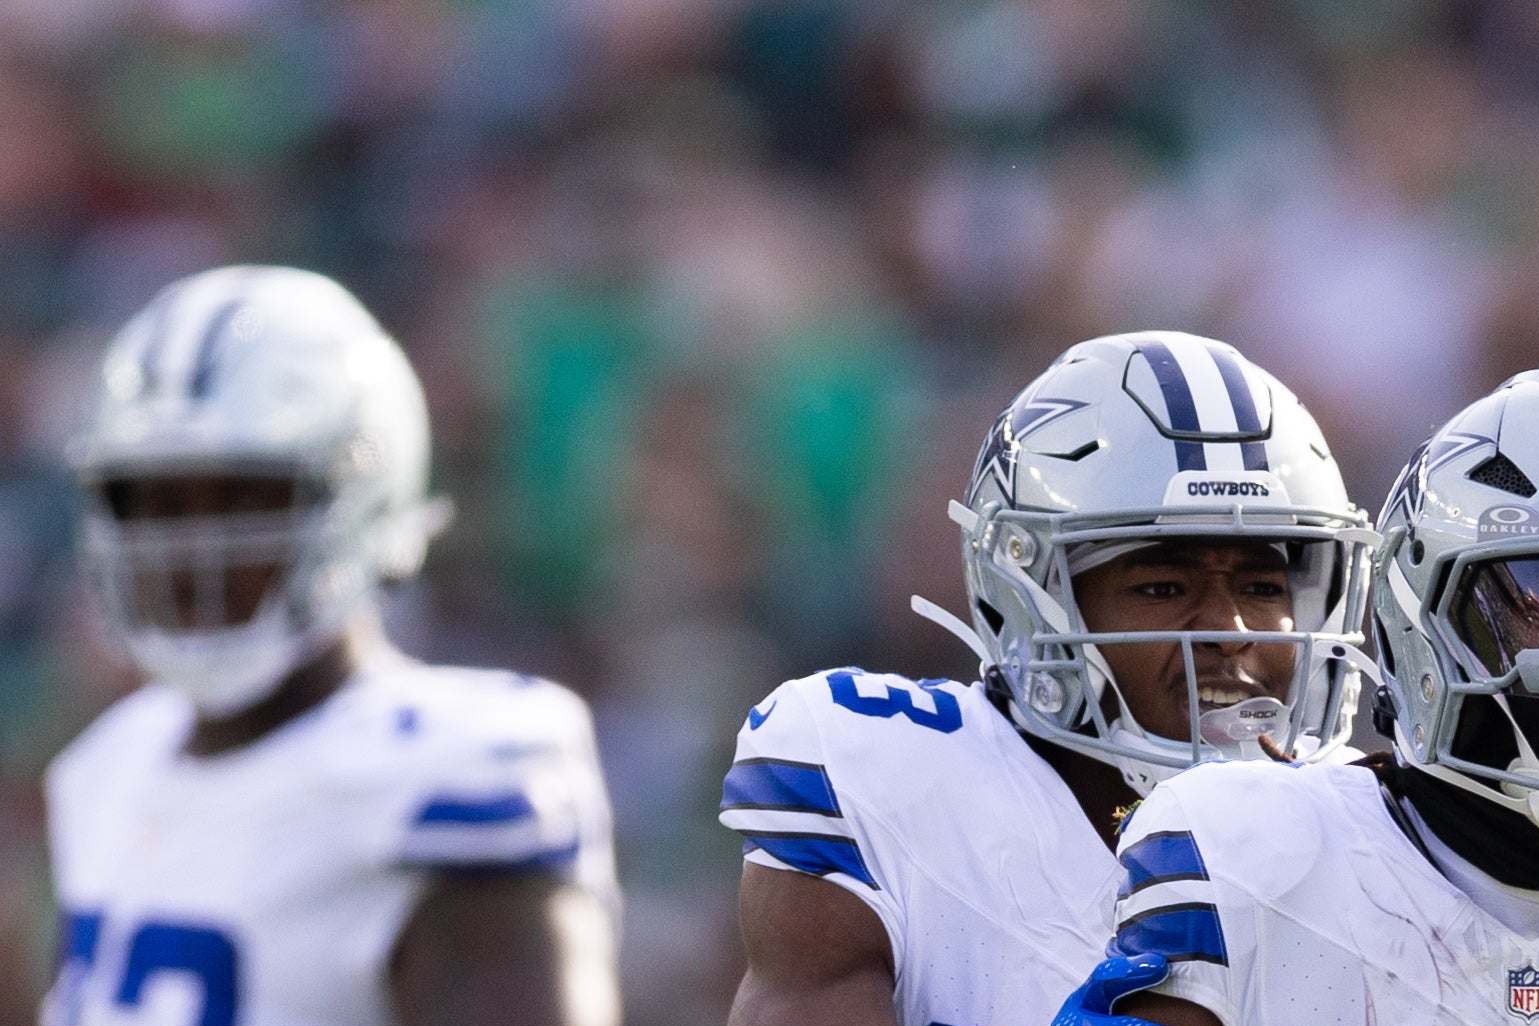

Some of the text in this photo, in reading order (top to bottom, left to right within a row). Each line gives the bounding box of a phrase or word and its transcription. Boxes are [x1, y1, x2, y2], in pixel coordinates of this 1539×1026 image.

[1187, 481, 1270, 497] COWBOYS
[1479, 524, 1539, 534] OAKLEY
[806, 665, 964, 735] 3
[1239, 708, 1279, 719] SHOCK
